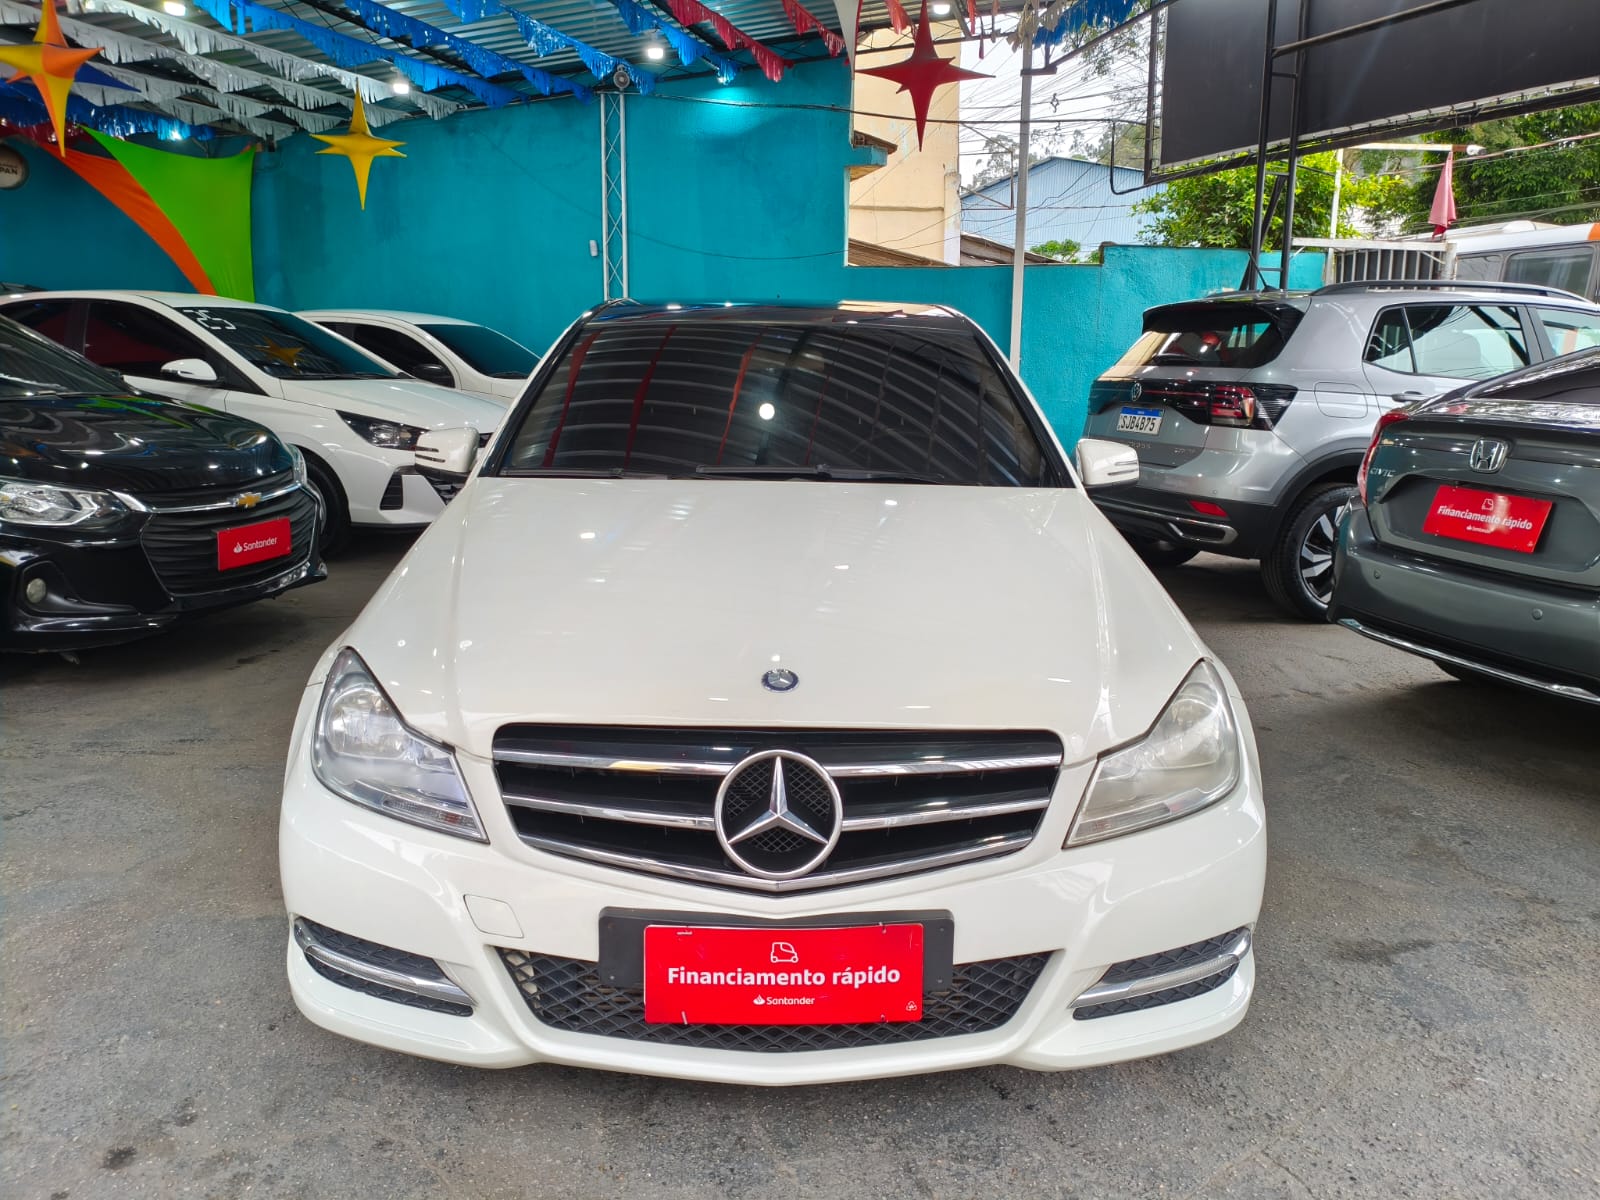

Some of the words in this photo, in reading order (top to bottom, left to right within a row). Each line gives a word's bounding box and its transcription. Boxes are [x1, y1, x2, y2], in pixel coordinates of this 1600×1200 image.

[1437, 505, 1501, 524] Financiamento
[1502, 516, 1533, 530] rápido
[243, 537, 278, 552] Santander
[667, 966, 826, 986] Financiamento
[832, 965, 901, 989] rápido
[766, 996, 816, 1006] Santander
